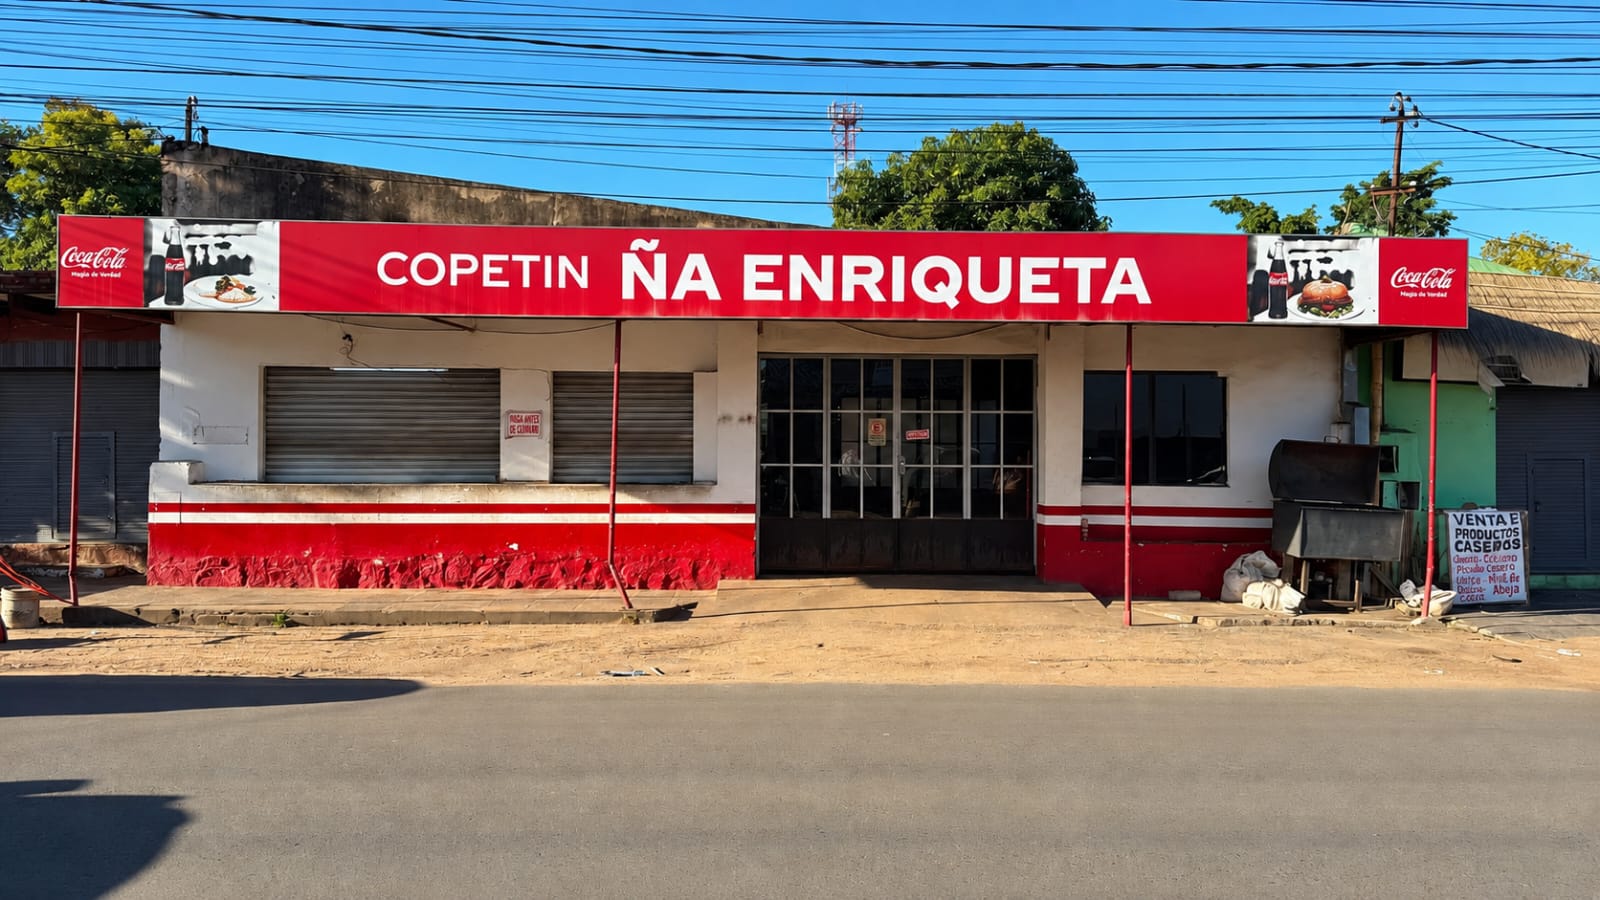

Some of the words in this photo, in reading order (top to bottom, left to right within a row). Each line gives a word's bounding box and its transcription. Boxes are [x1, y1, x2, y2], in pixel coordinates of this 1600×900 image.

[61, 246, 129, 269] Coca-Cola
[376, 252, 589, 289] COPETIN
[621, 239, 722, 301] ÑA
[743, 254, 1152, 310] ENRIQUETA
[1391, 266, 1456, 289] Coca-Cola
[1453, 514, 1507, 526] VENTA
[1455, 528, 1519, 540] PRODUCTOS
